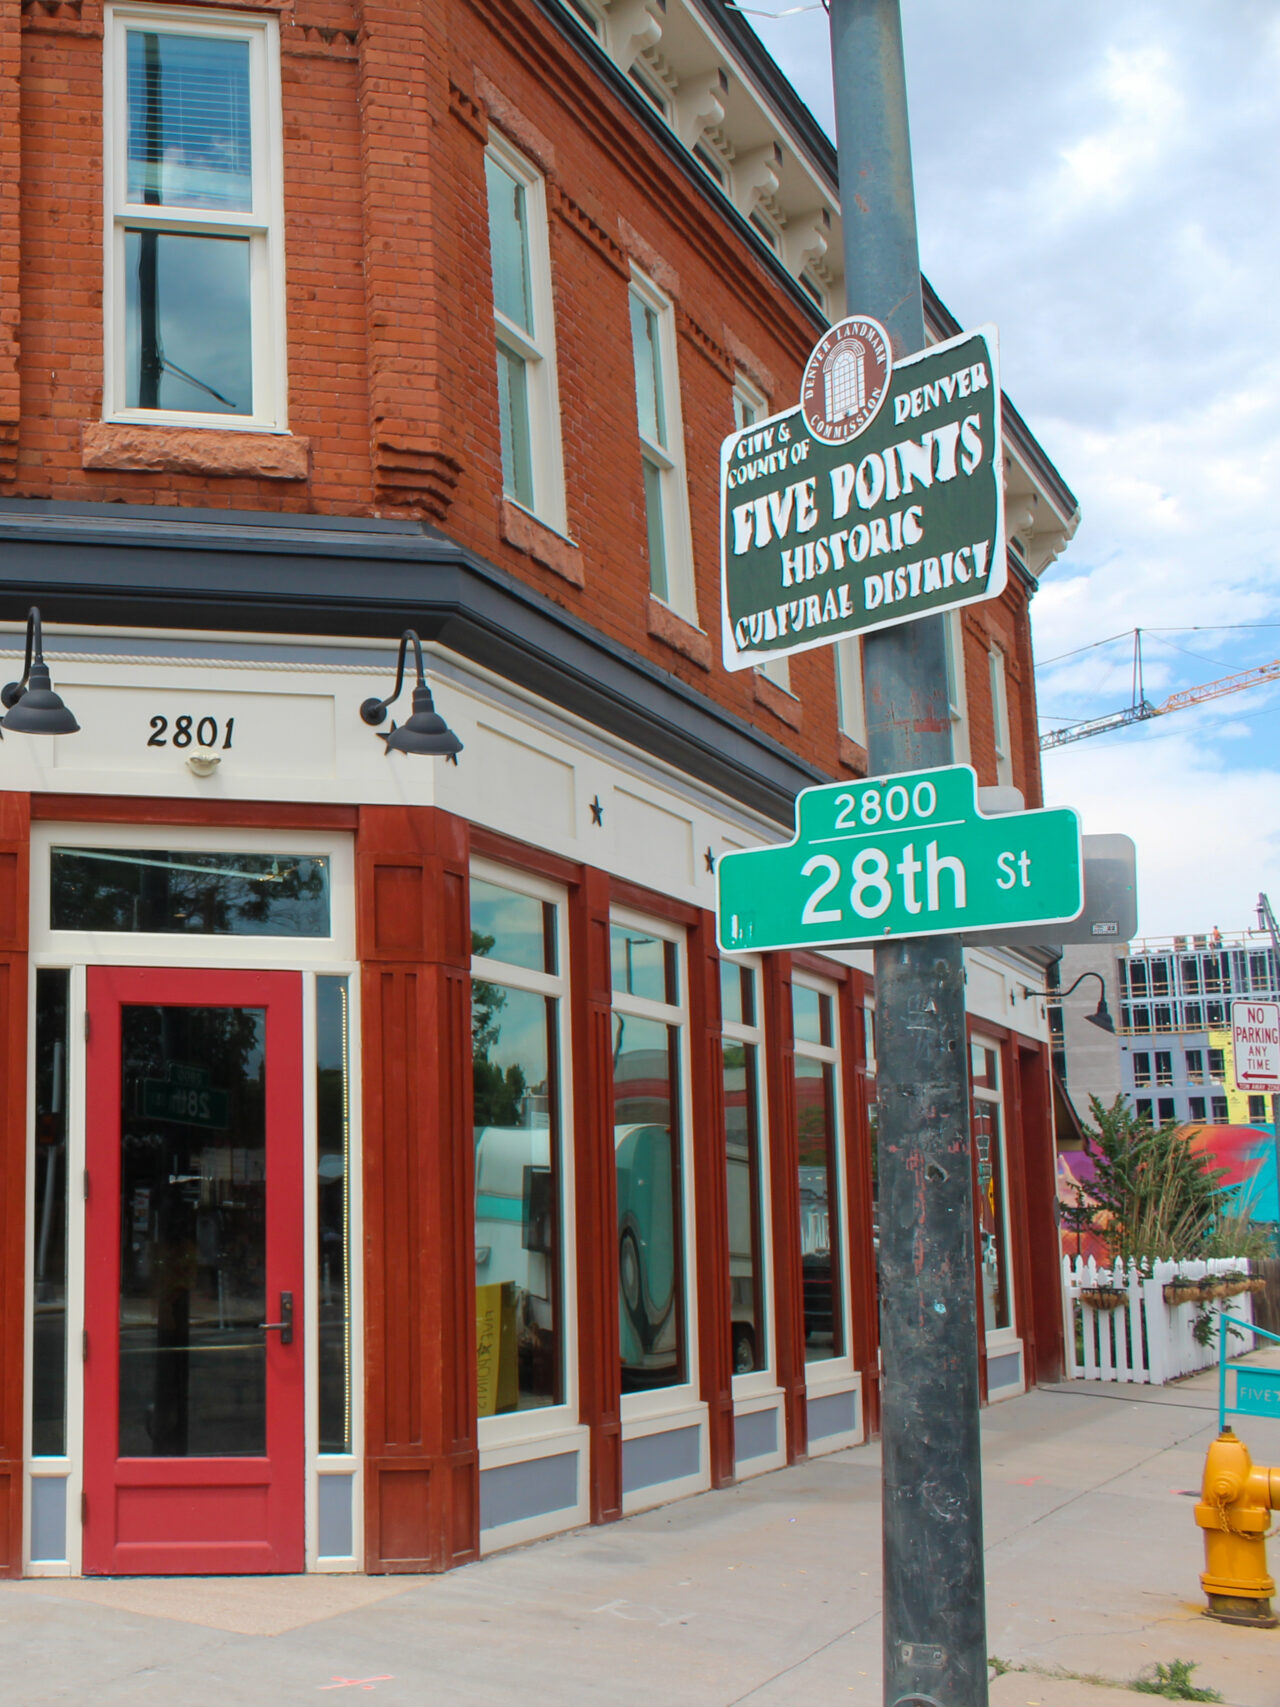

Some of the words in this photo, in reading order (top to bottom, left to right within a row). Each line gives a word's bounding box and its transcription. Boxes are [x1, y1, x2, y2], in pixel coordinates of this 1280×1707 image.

[805, 341, 831, 400] DENVER
[836, 323, 886, 366] LANDMARK
[810, 387, 882, 439] COMMISSION
[894, 362, 989, 425] DENVER
[728, 448, 789, 489] COUNTY
[791, 438, 810, 465] OF
[737, 427, 775, 459] CITY
[778, 423, 791, 443] &
[732, 476, 818, 555] FIVE
[829, 413, 984, 519] POINTS
[781, 505, 924, 587] HISTORIC
[734, 584, 853, 650] CULTURAL
[864, 540, 989, 610] DISTRICT
[147, 715, 235, 749] 2801
[834, 781, 937, 829] 2800
[800, 840, 967, 925] 28th
[996, 850, 1032, 890] St
[1236, 1026, 1279, 1045] PARKING
[1248, 1007, 1264, 1024] NO
[1247, 1059, 1270, 1070] TIME
[1249, 1045, 1267, 1057] ANY
[1240, 1386, 1272, 1402] FIVE
